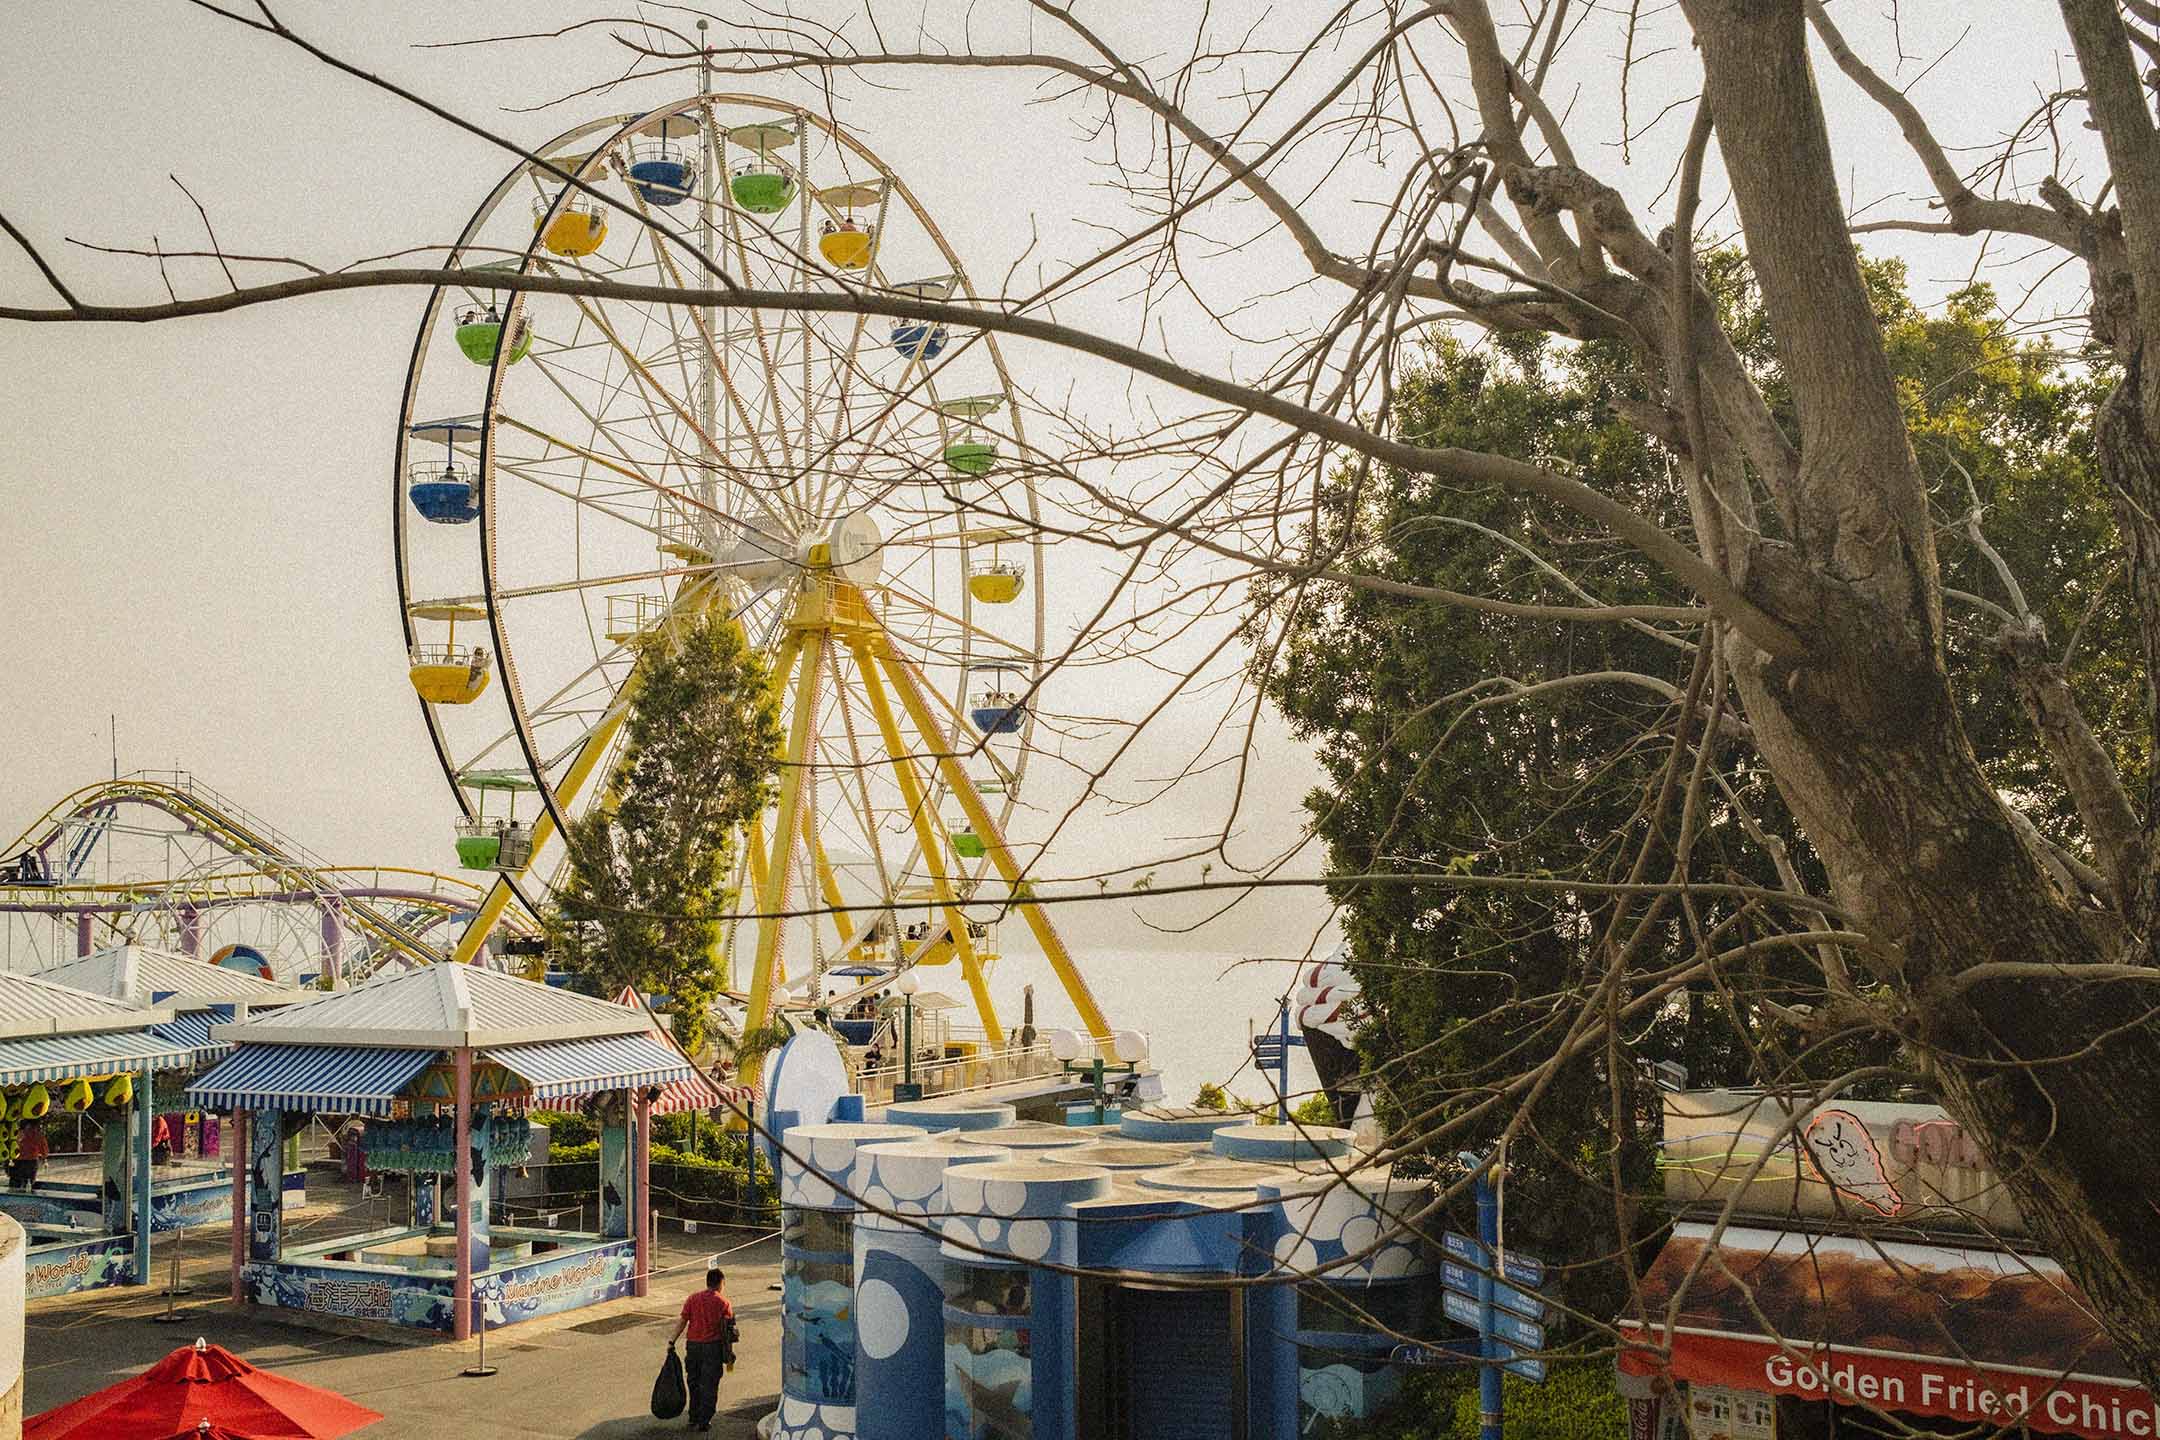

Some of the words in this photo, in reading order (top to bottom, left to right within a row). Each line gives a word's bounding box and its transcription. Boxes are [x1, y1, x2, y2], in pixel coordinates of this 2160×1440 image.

[35, 1251, 91, 1284] World
[504, 1276, 561, 1305] Marine
[561, 1256, 605, 1284] World
[303, 1278, 393, 1313] 海洋天地
[1764, 1355, 1905, 1403] Golden
[1920, 1373, 2030, 1420] Fried
